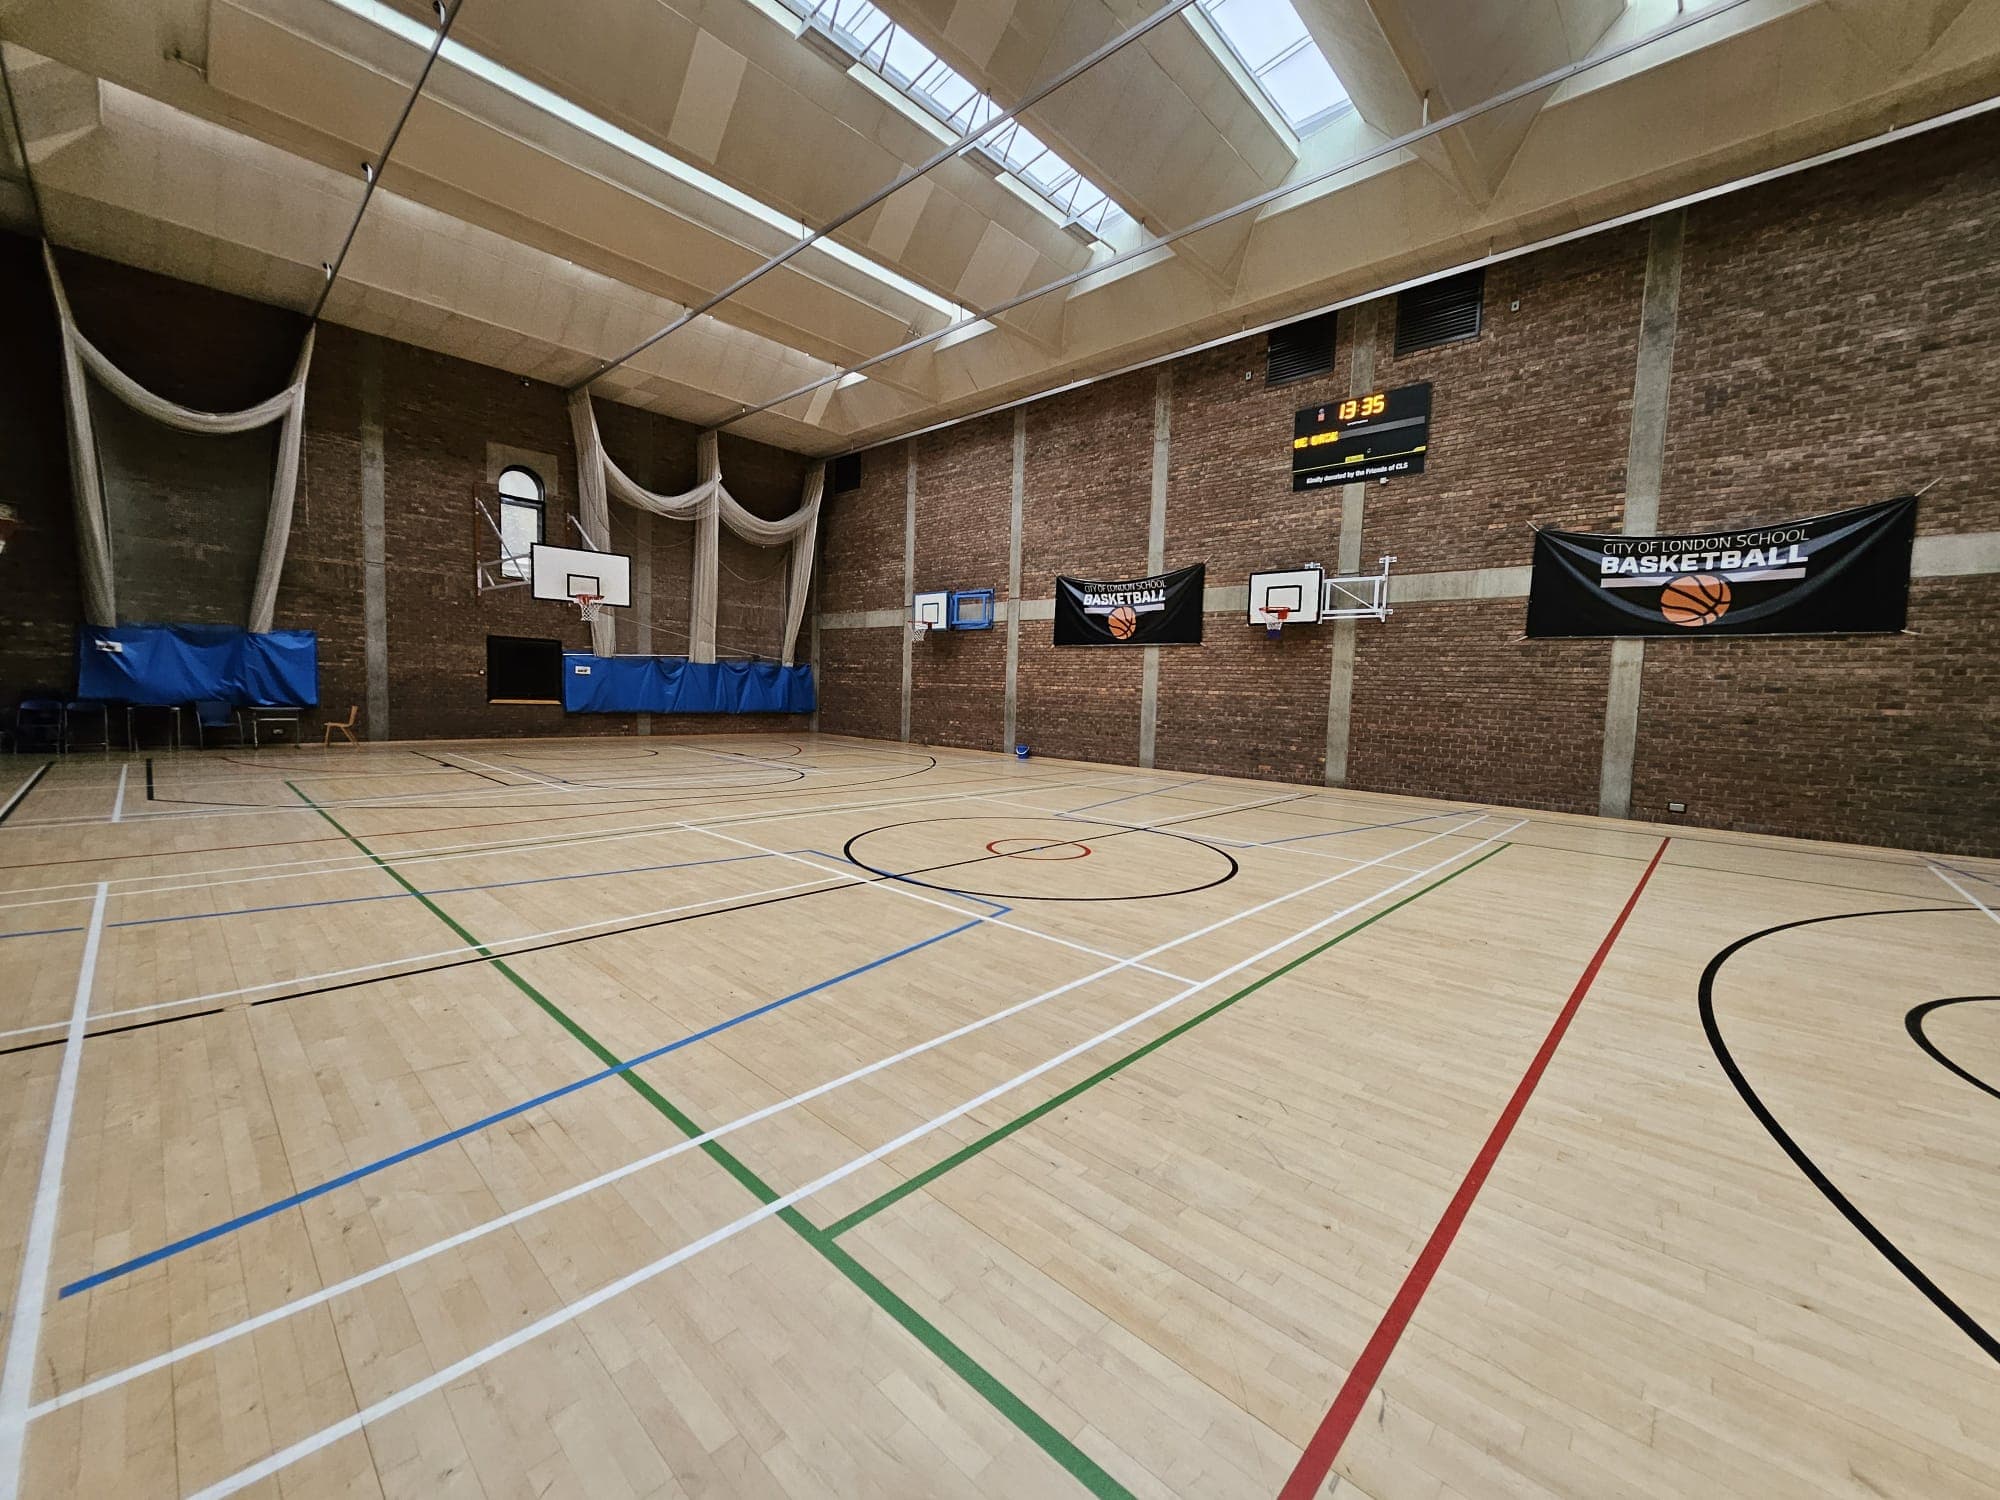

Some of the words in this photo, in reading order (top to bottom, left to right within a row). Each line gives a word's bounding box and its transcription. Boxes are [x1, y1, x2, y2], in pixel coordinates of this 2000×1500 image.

[1339, 394, 1385, 420] 13:35
[1347, 471, 1355, 479] by
[1388, 463, 1395, 471] of
[1603, 542, 1635, 555] CITY
[1638, 541, 1657, 554] OF
[1662, 536, 1731, 553] LONDON
[1736, 528, 1810, 548] SCHOOL
[1600, 544, 1809, 575] BASKETBALL
[1085, 584, 1097, 593] CITY
[1097, 584, 1106, 592] OF
[1107, 582, 1136, 592] LONDON
[1136, 579, 1166, 590] SCHOOL
[1083, 589, 1166, 606] BASKETBALL
